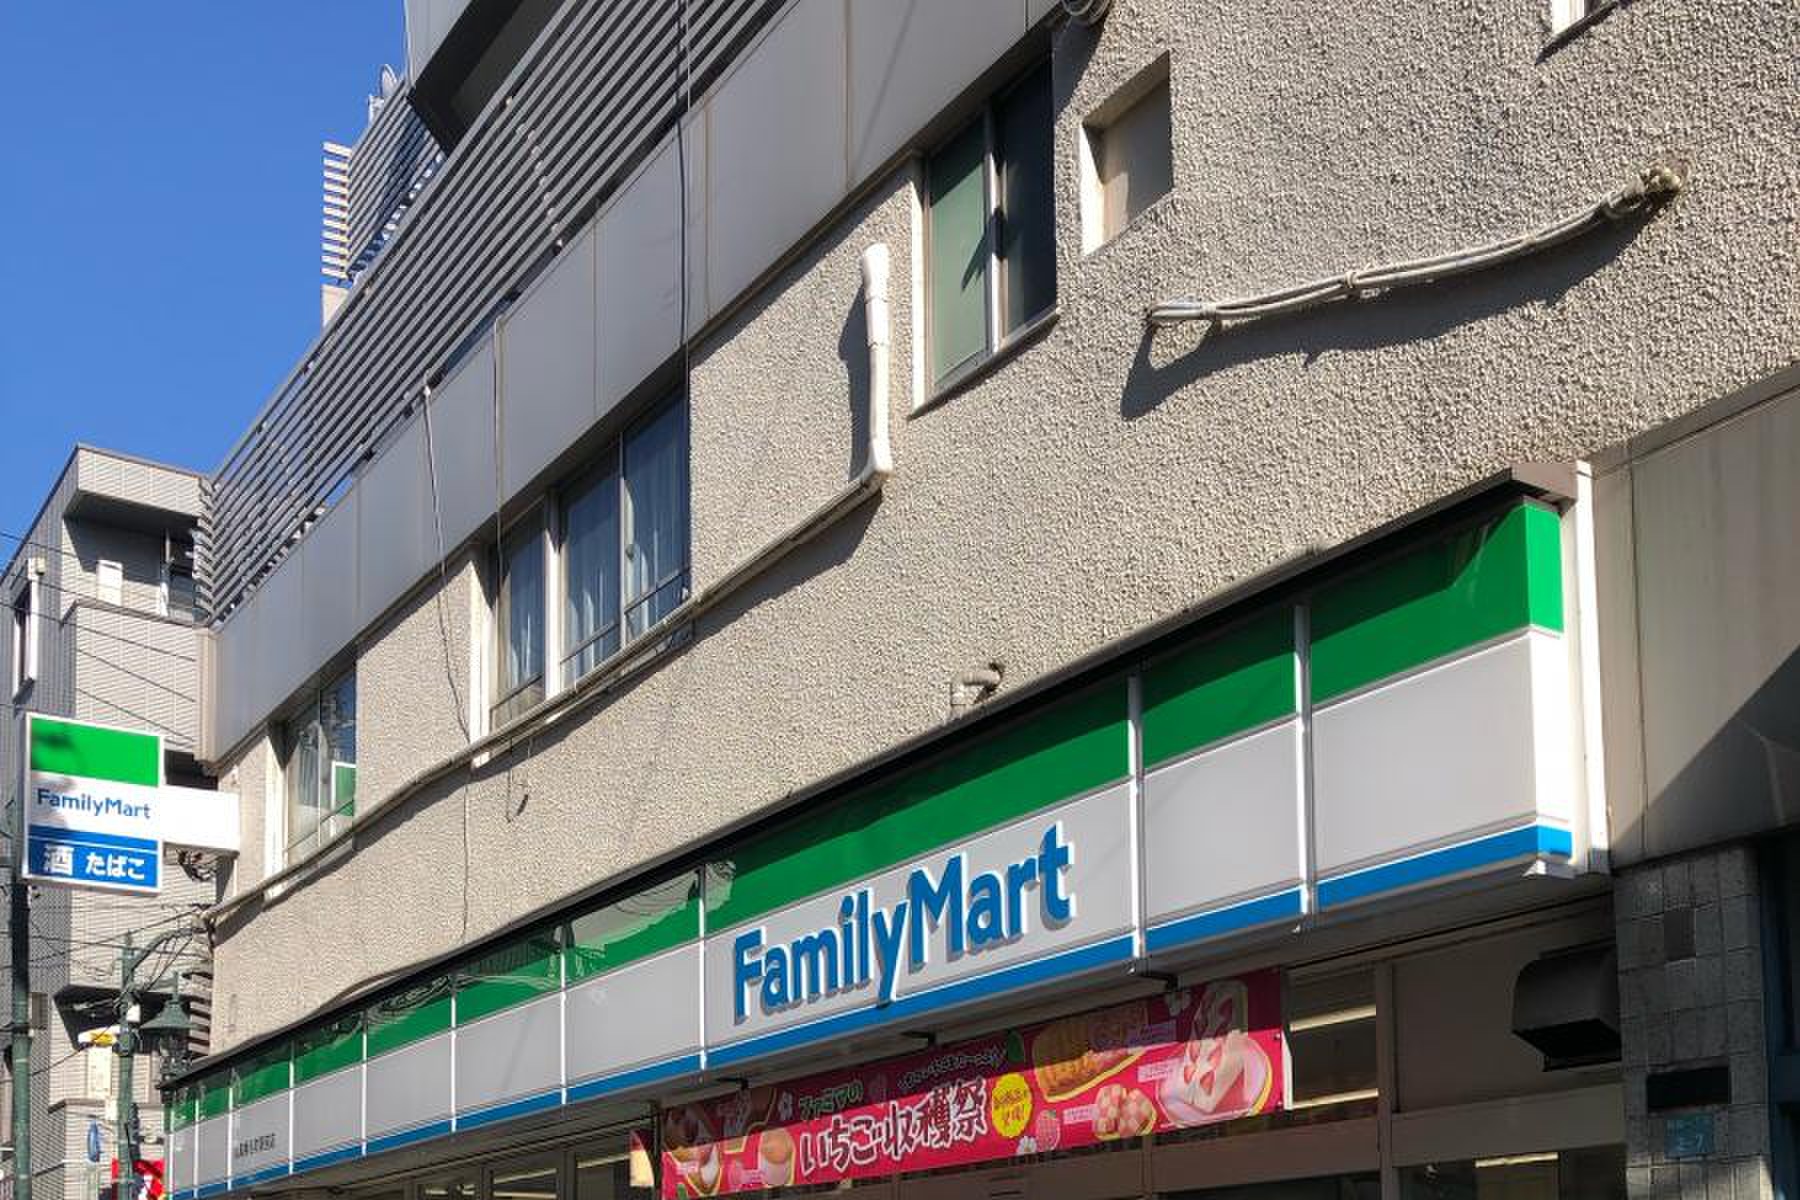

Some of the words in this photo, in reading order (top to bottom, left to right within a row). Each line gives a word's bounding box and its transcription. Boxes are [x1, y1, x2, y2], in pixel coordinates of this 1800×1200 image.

[36, 788, 151, 819] FamilyMart
[44, 845, 74, 876] 酒
[85, 851, 145, 880] たばこ
[734, 821, 1077, 1023] FamilyMart
[799, 1075, 989, 1177] いちご収穫祭
